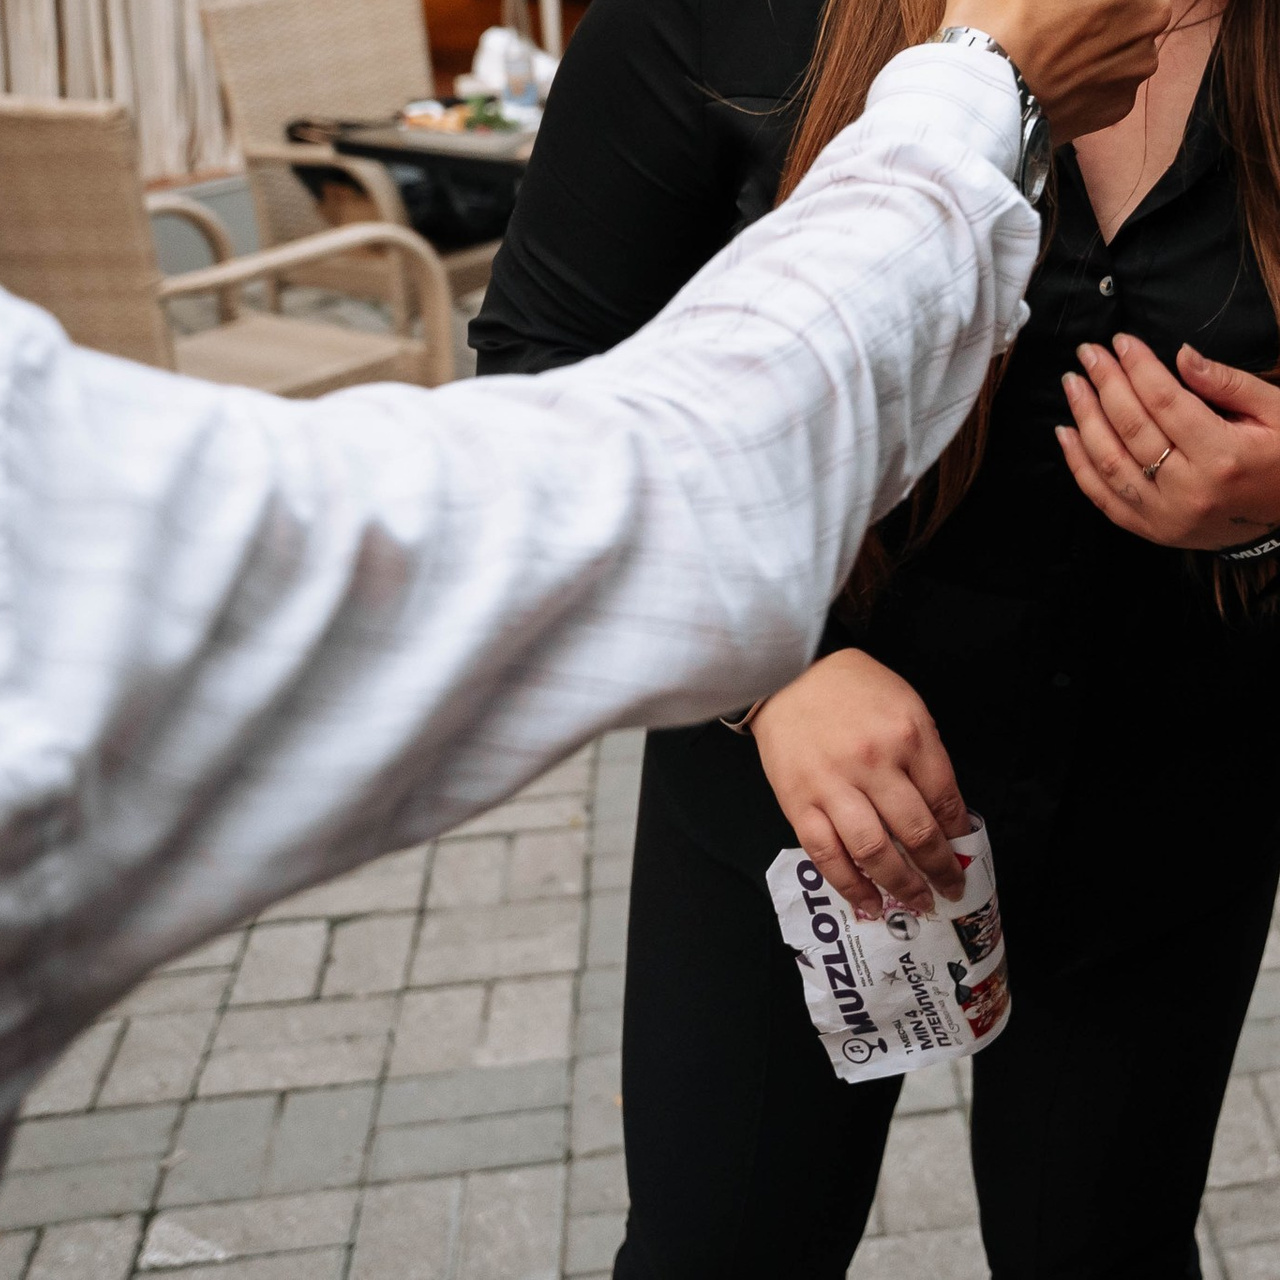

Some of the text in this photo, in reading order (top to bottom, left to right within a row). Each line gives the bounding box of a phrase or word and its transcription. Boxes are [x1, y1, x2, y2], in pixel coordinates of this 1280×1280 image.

[796, 859, 879, 1036] MUZLOTO
[898, 951, 952, 1047] ПЛЕЙЛИСТА
[892, 1019, 912, 1048] МЕСЯЦ
[910, 1020, 934, 1051] MIN
